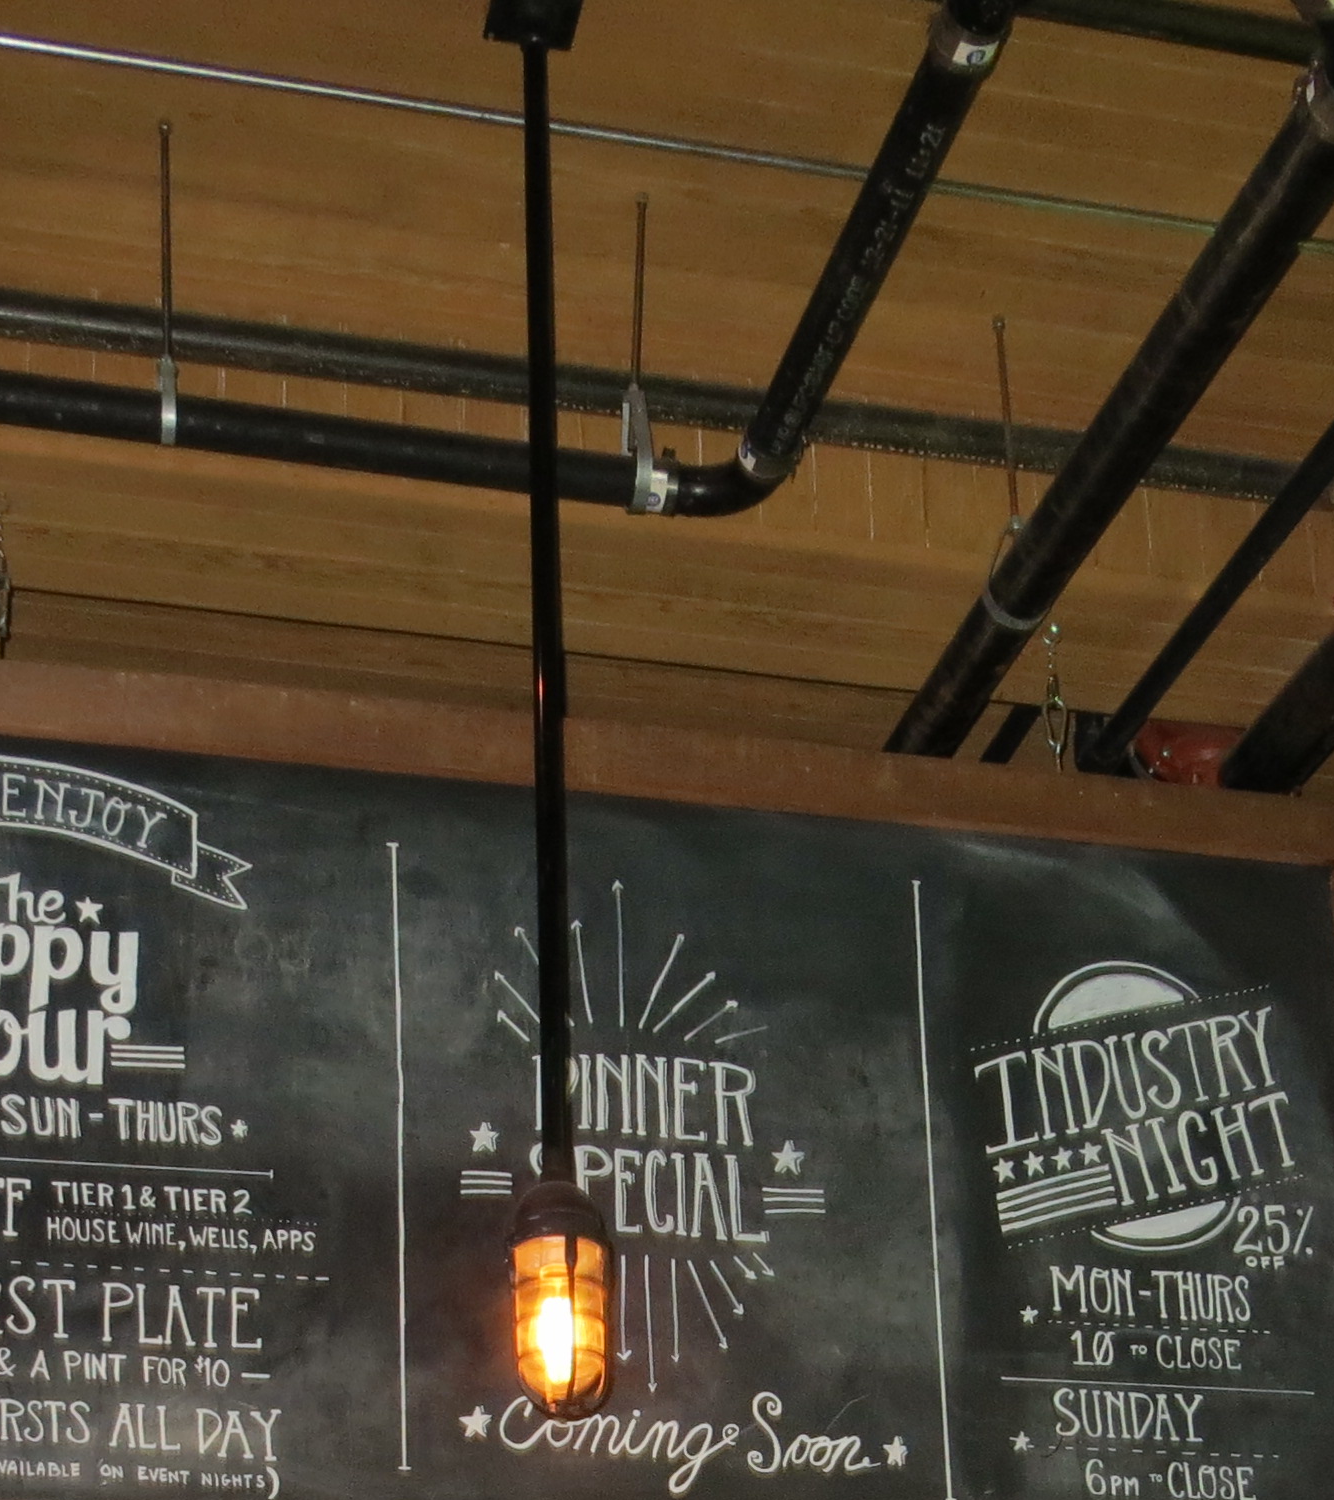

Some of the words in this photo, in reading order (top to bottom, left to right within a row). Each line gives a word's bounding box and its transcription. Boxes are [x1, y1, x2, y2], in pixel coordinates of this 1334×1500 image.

[2, 774, 166, 850] ENJOY
[974, 1006, 1277, 1153] INDUSTRY
[109, 1096, 223, 1146] THURS
[1101, 1091, 1296, 1206] NIGHT
[52, 1180, 116, 1209] TIER
[163, 1187, 229, 1214] TIER
[233, 1189, 253, 1214] 2
[47, 1216, 119, 1244] HOUSE
[125, 1221, 186, 1252] WINE,
[188, 1226, 257, 1253] WELLS,
[262, 1229, 315, 1252] APPS
[1233, 1205, 1314, 1256] 25%
[1245, 1255, 1285, 1269] OFF
[102, 1282, 262, 1349] PLATE
[30, 1349, 50, 1382] A
[66, 1350, 126, 1384] PINT
[143, 1356, 187, 1383] FOR
[195, 1356, 230, 1387] $10
[1070, 1330, 1116, 1366] 10
[1130, 1344, 1148, 1356] TO
[1156, 1337, 1242, 1370] CLOSE
[109, 1403, 181, 1451] ALL
[197, 1408, 281, 1462] DAY
[1053, 1387, 1204, 1442] SUNDAY
[499, 1394, 741, 1494] Coming
[747, 1392, 879, 1474] Soon
[99, 1466, 123, 1480] ON
[138, 1467, 191, 1487] EVENT
